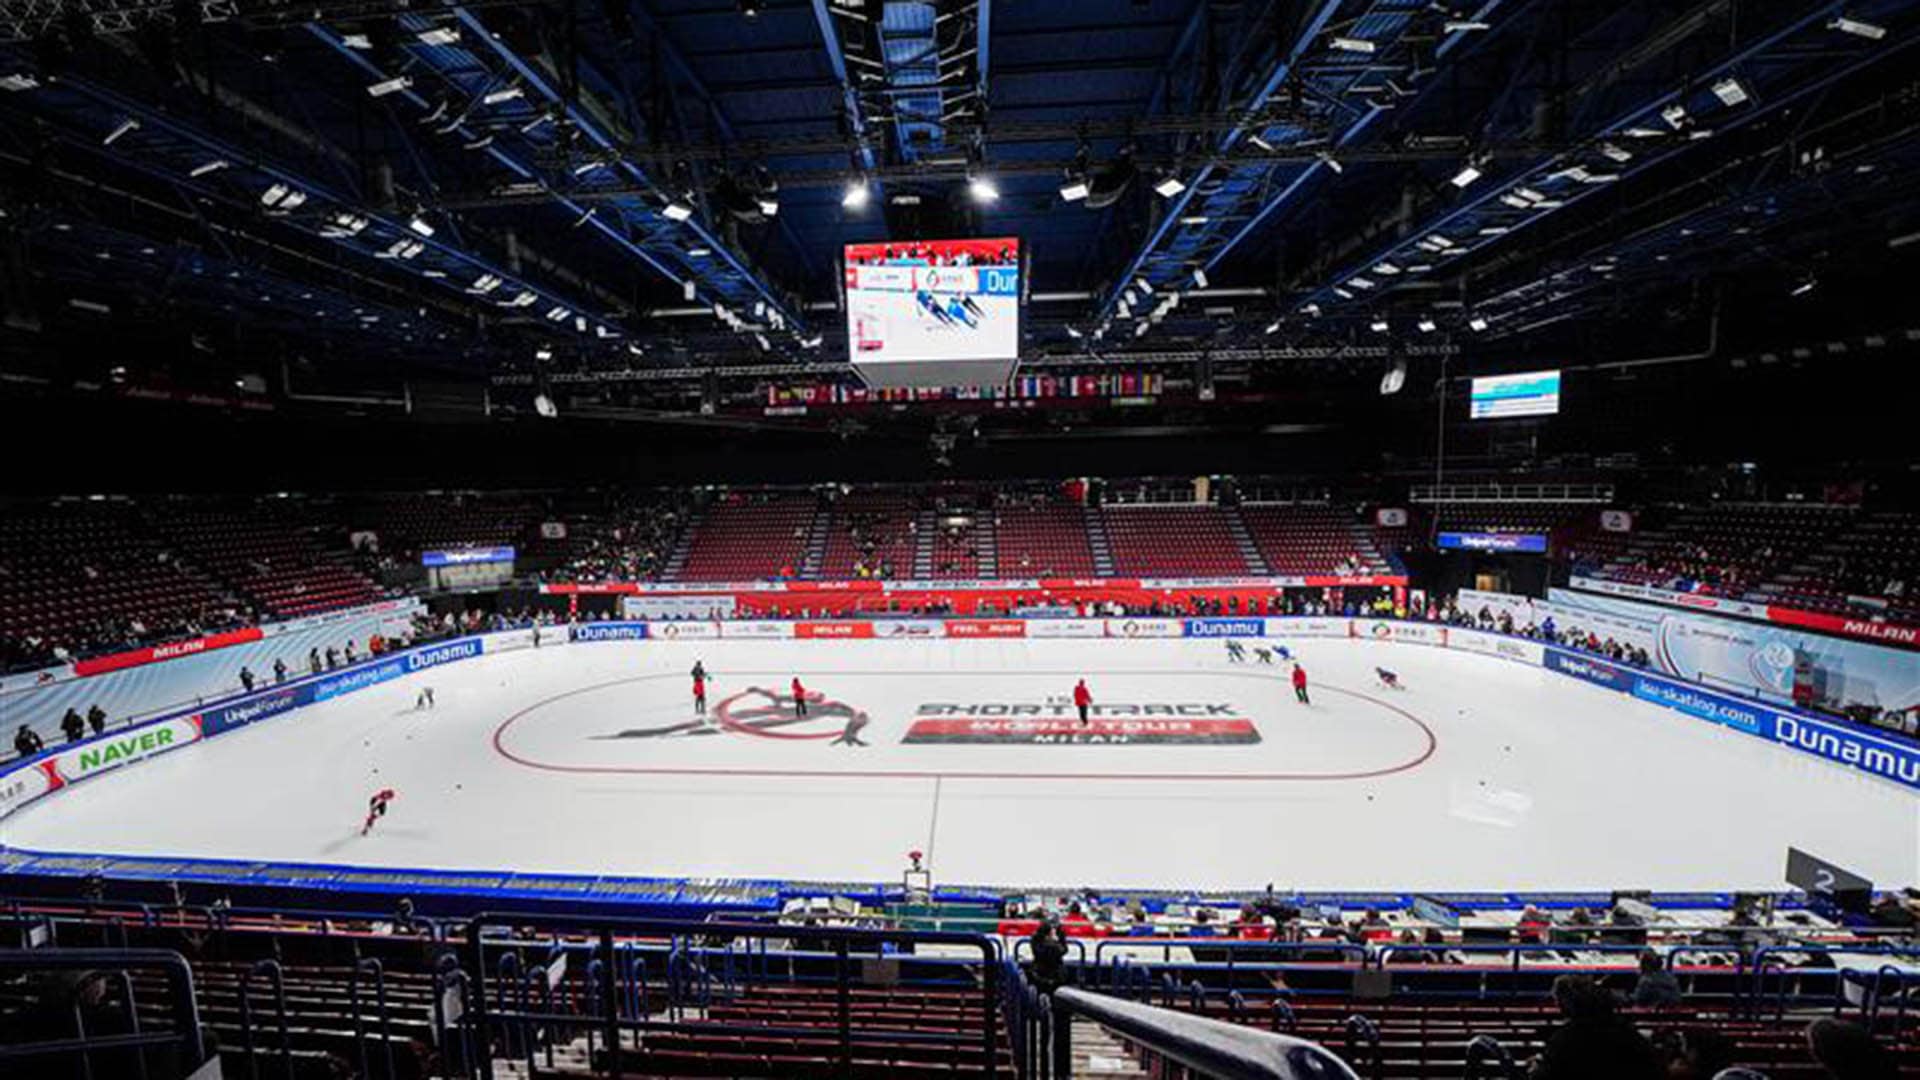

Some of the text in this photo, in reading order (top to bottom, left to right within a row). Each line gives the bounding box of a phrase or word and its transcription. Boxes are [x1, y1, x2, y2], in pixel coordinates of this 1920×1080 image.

[576, 626, 642, 641] Dunamu
[1192, 620, 1259, 635] Dunamu
[1843, 621, 1917, 641] MILAN
[153, 639, 206, 659] MILAN
[408, 643, 476, 671] Dunamu
[917, 704, 1072, 716] SHORT
[1097, 721, 1193, 731] TOUR
[79, 727, 174, 771] NAVER
[1033, 734, 1129, 745] MILAN
[1776, 716, 1919, 782] Dunamu
[1815, 869, 1835, 896] 2
